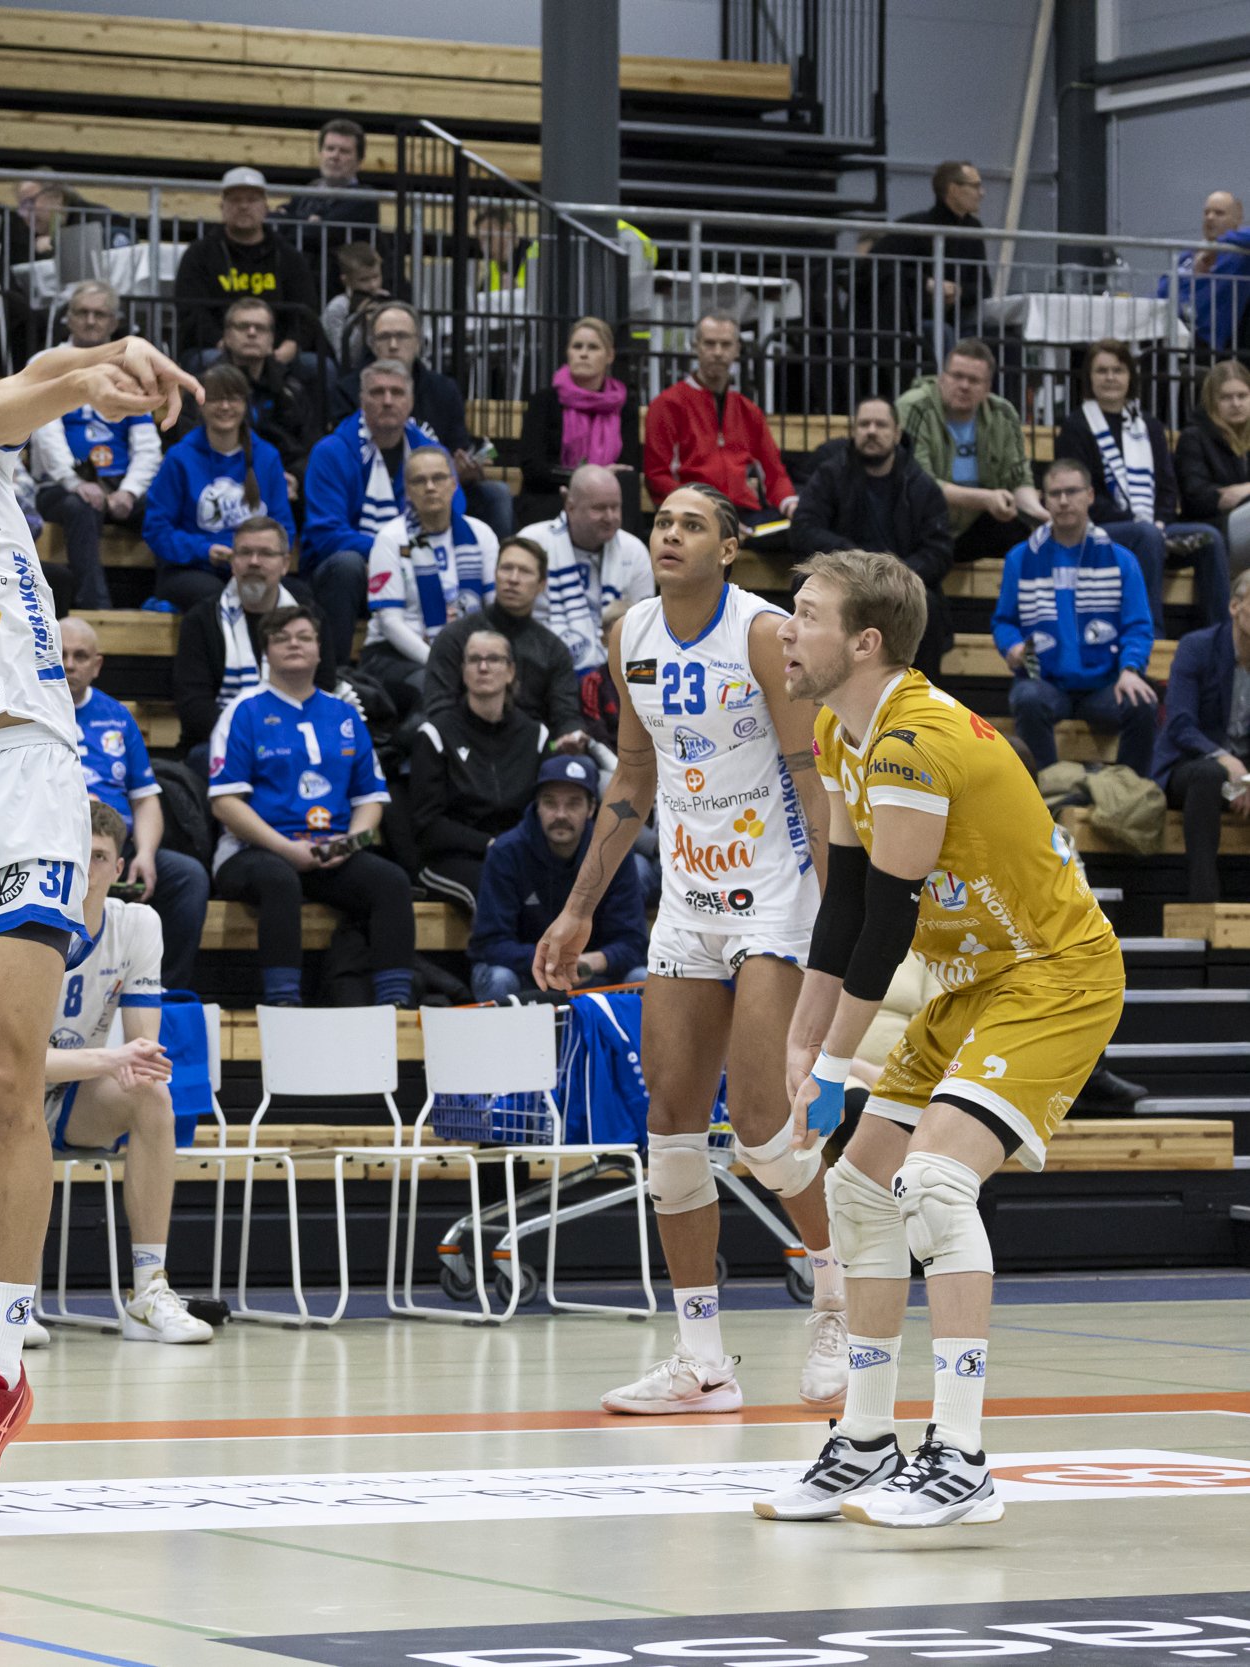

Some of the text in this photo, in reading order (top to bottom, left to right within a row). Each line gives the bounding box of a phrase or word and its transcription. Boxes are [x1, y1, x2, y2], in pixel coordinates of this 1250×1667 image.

[218, 267, 277, 295] viega
[662, 661, 707, 715] 23
[296, 721, 322, 765] 1
[671, 823, 756, 881] Akaa
[38, 858, 75, 906] 31
[63, 974, 84, 1018] 8
